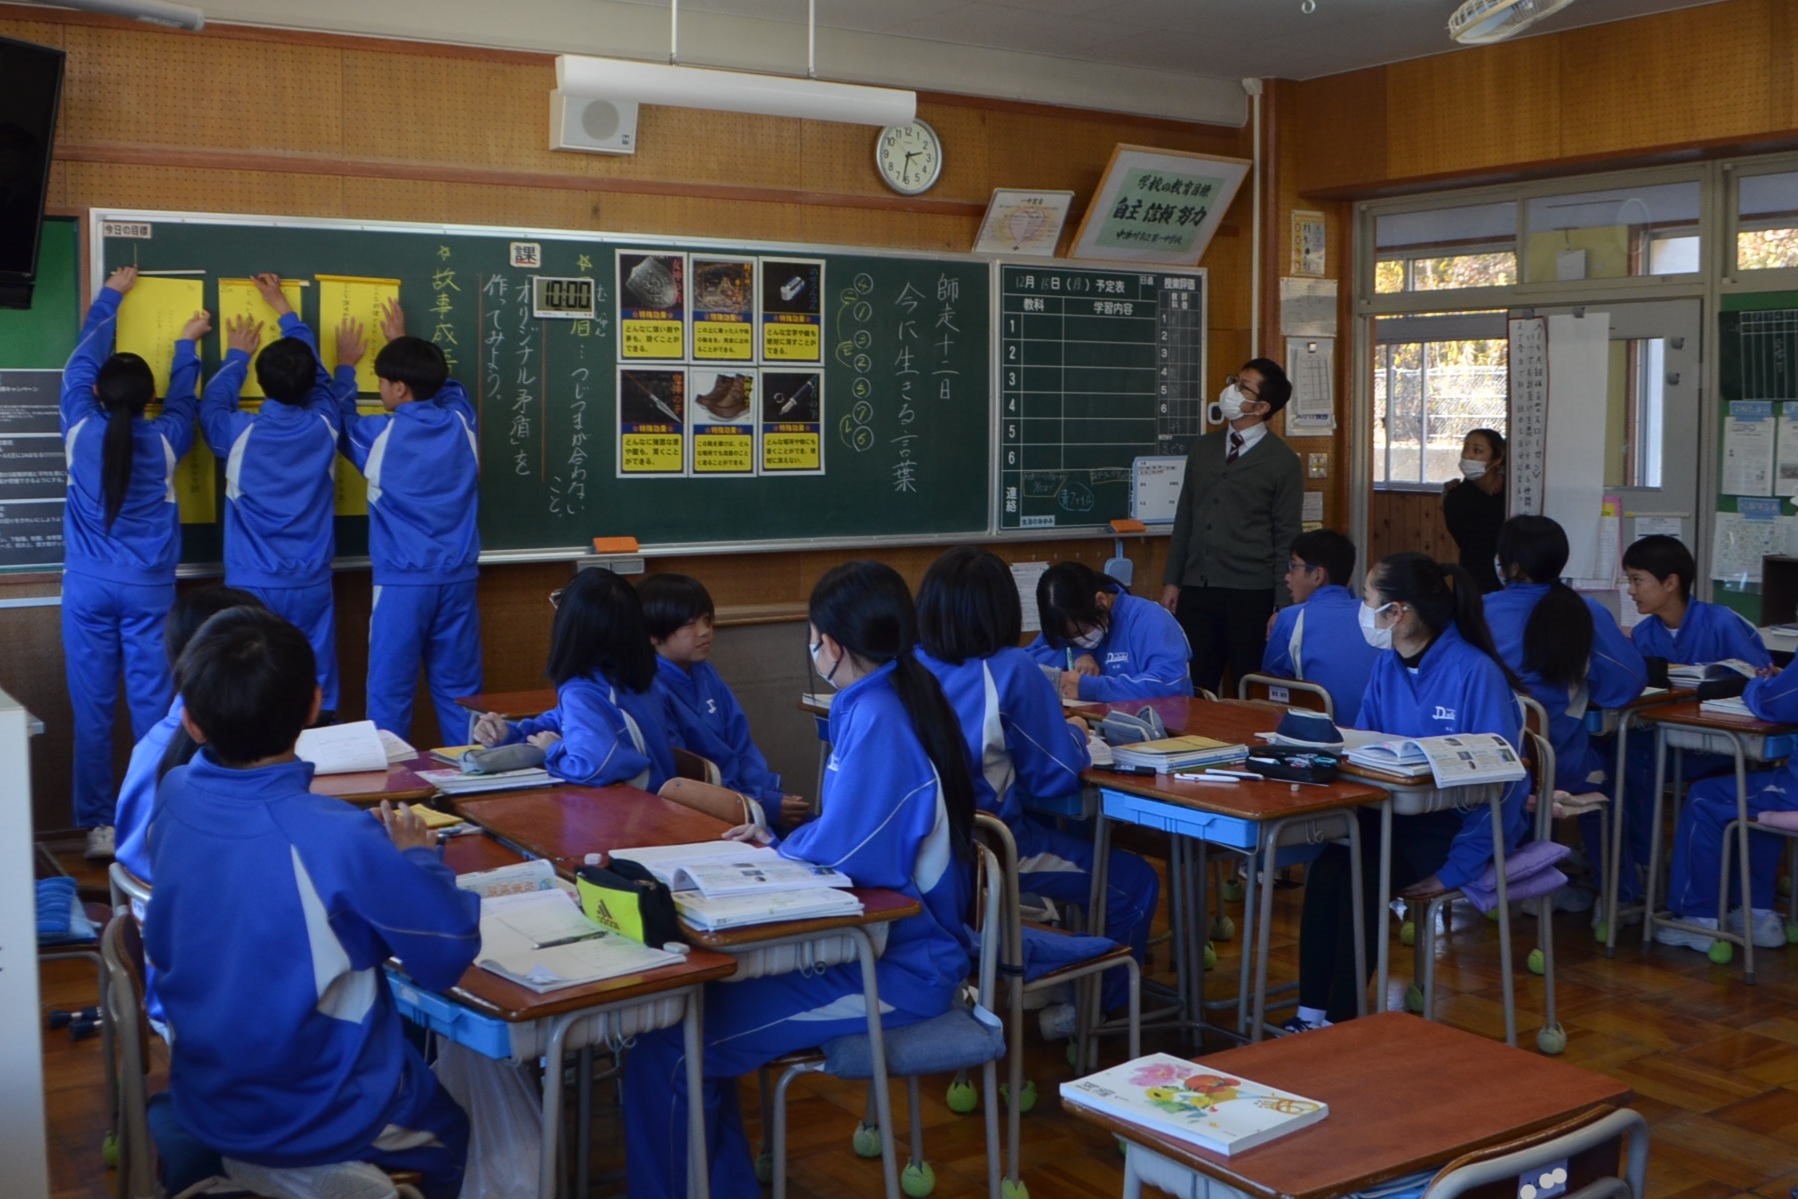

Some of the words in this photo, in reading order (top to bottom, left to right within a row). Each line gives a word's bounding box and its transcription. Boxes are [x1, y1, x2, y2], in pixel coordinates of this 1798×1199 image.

[1137, 174, 1212, 198] 学校の教育目標
[1112, 196, 1143, 221] 自主
[1143, 202, 1174, 225] 信頼
[1176, 204, 1208, 227] 努力
[105, 224, 148, 236] 今日の目標
[514, 246, 536, 264] 課
[545, 281, 591, 308] 10:00
[1023, 298, 1045, 312] 教科
[1093, 301, 1134, 315] 学習内容
[1009, 319, 1015, 332] 1
[483, 274, 508, 400] 作ってみよう。
[931, 273, 961, 399] 師走十二日
[1009, 346, 1016, 359] 2
[1009, 373, 1016, 385] 3
[890, 281, 927, 493] 今に生きる言葉
[1008, 399, 1016, 412] 4
[1009, 425, 1016, 438] 5
[1008, 451, 1015, 464] 6
[1005, 487, 1017, 513] 連絡
